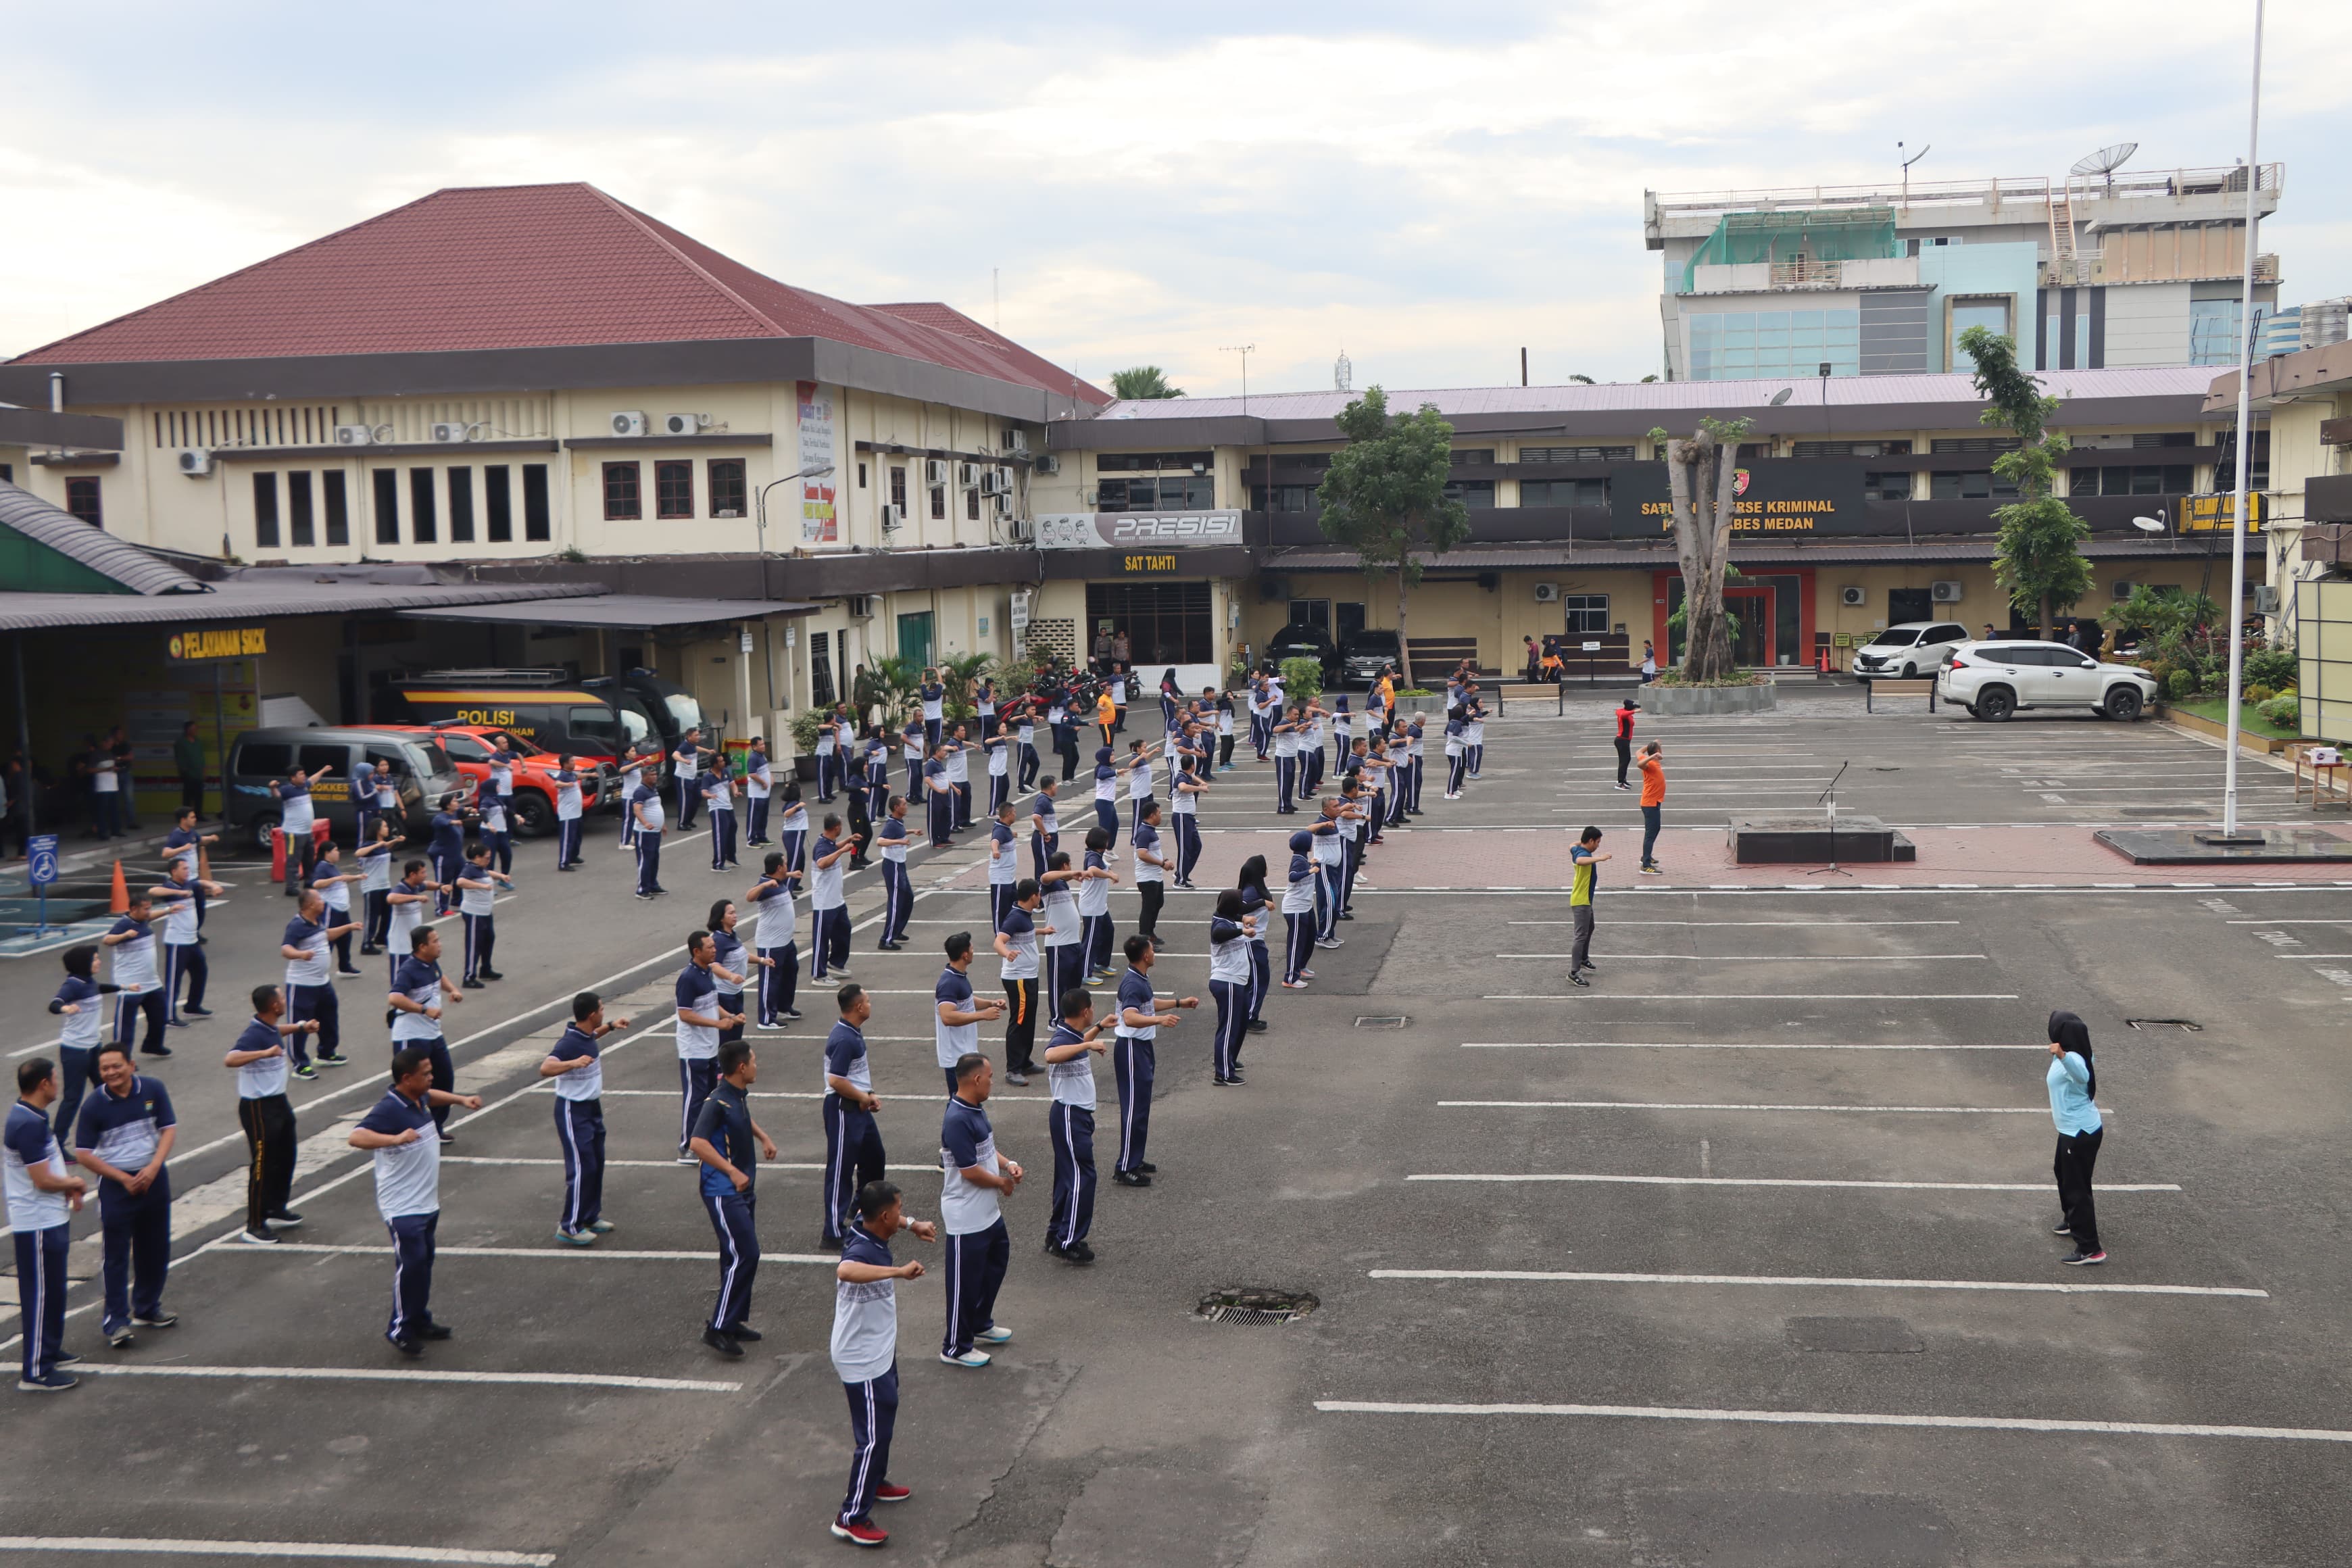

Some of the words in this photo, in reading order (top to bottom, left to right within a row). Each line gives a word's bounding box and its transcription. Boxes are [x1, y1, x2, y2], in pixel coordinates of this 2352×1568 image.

[1767, 500, 1835, 513] KRIMINAL
[1114, 516, 1238, 536] PRESISI
[1764, 517, 1813, 530] MEDAN
[1125, 556, 1144, 571] SAT
[1146, 555, 1176, 571] TAHTI
[183, 630, 241, 659] PELAYANAN
[241, 628, 267, 654] SKCK
[457, 710, 515, 725] POLISI
[2197, 898, 2243, 912] TAMU
[2251, 931, 2307, 947] TAMU
